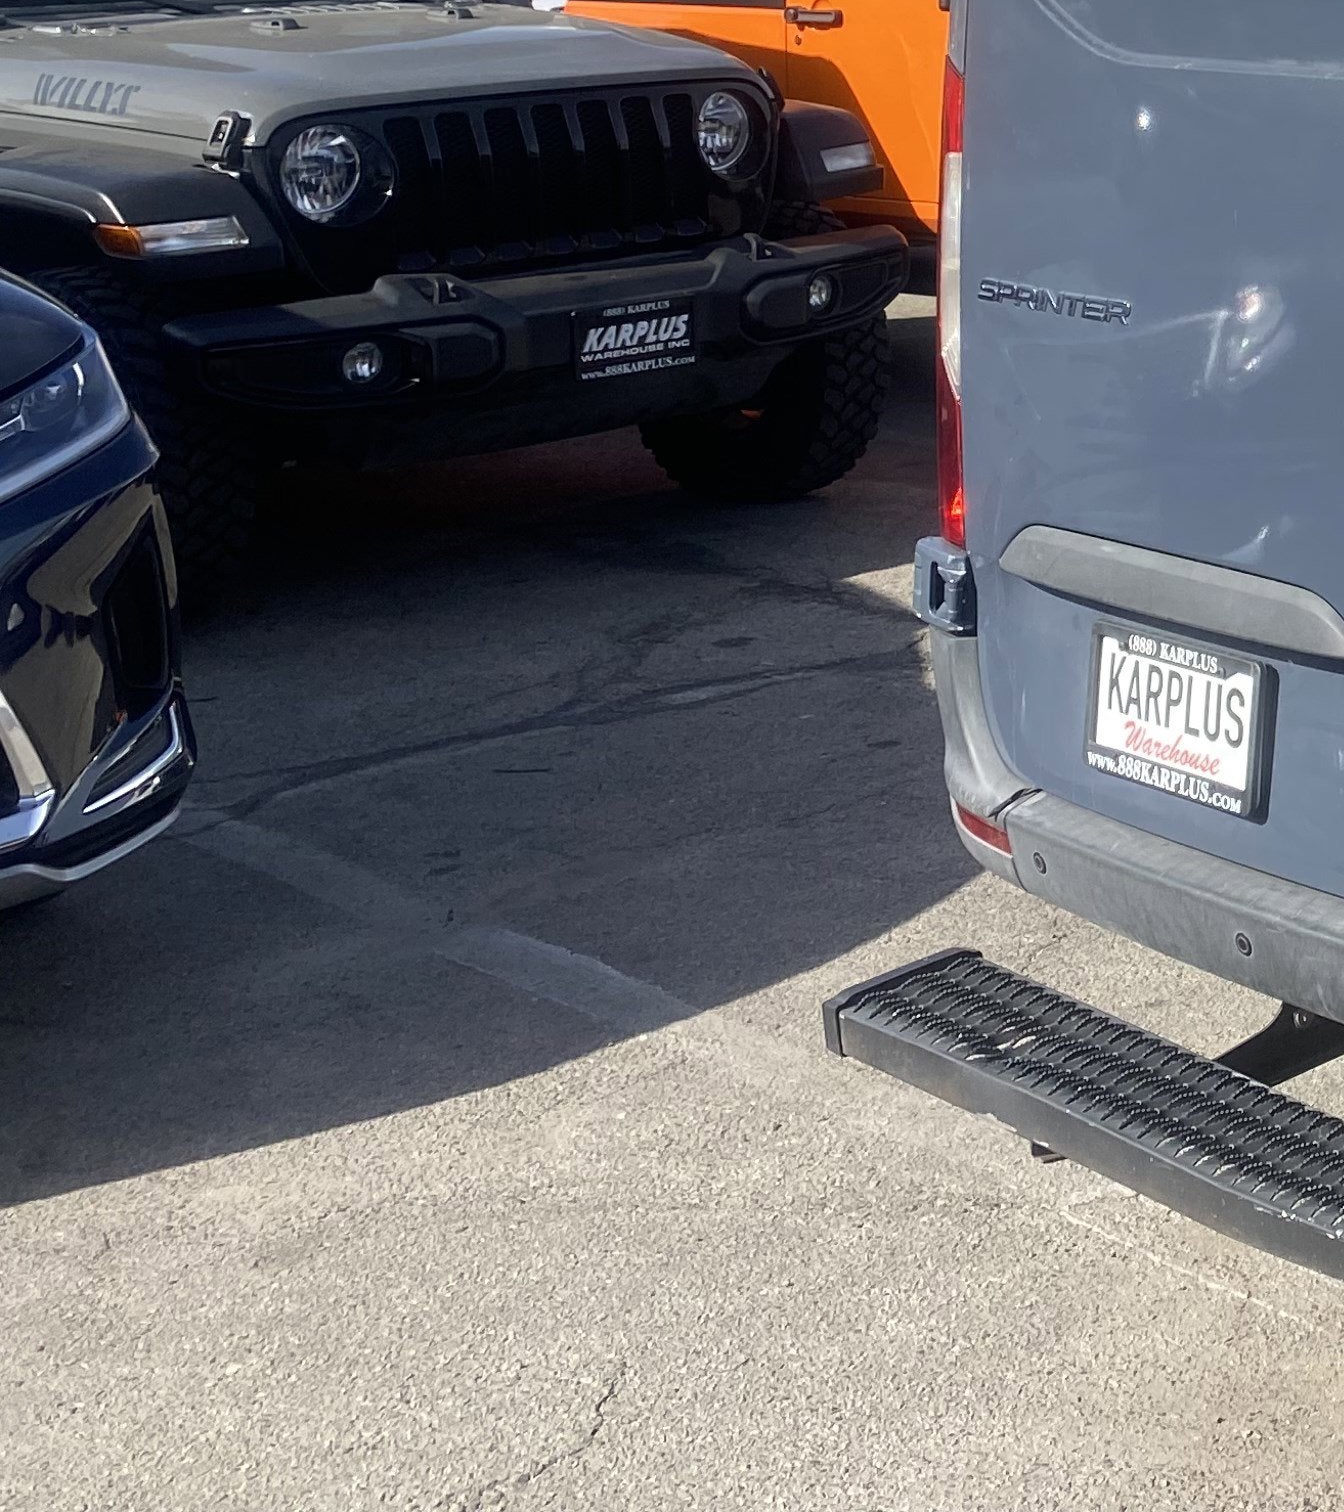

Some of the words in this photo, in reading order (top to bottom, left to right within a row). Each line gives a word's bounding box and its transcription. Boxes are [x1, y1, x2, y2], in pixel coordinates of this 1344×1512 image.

[33, 73, 142, 117] WILLYS
[627, 300, 670, 314] KARPLUS
[977, 277, 1133, 326] SPRINTER
[580, 343, 664, 363] WAREHOUSE
[667, 338, 690, 349] INC
[582, 313, 690, 353] KARPLUS
[1128, 634, 1157, 656] (888)
[1159, 642, 1218, 674] KARPLUS
[1107, 651, 1246, 749] KARPLUS
[1124, 720, 1221, 776] Warehouse
